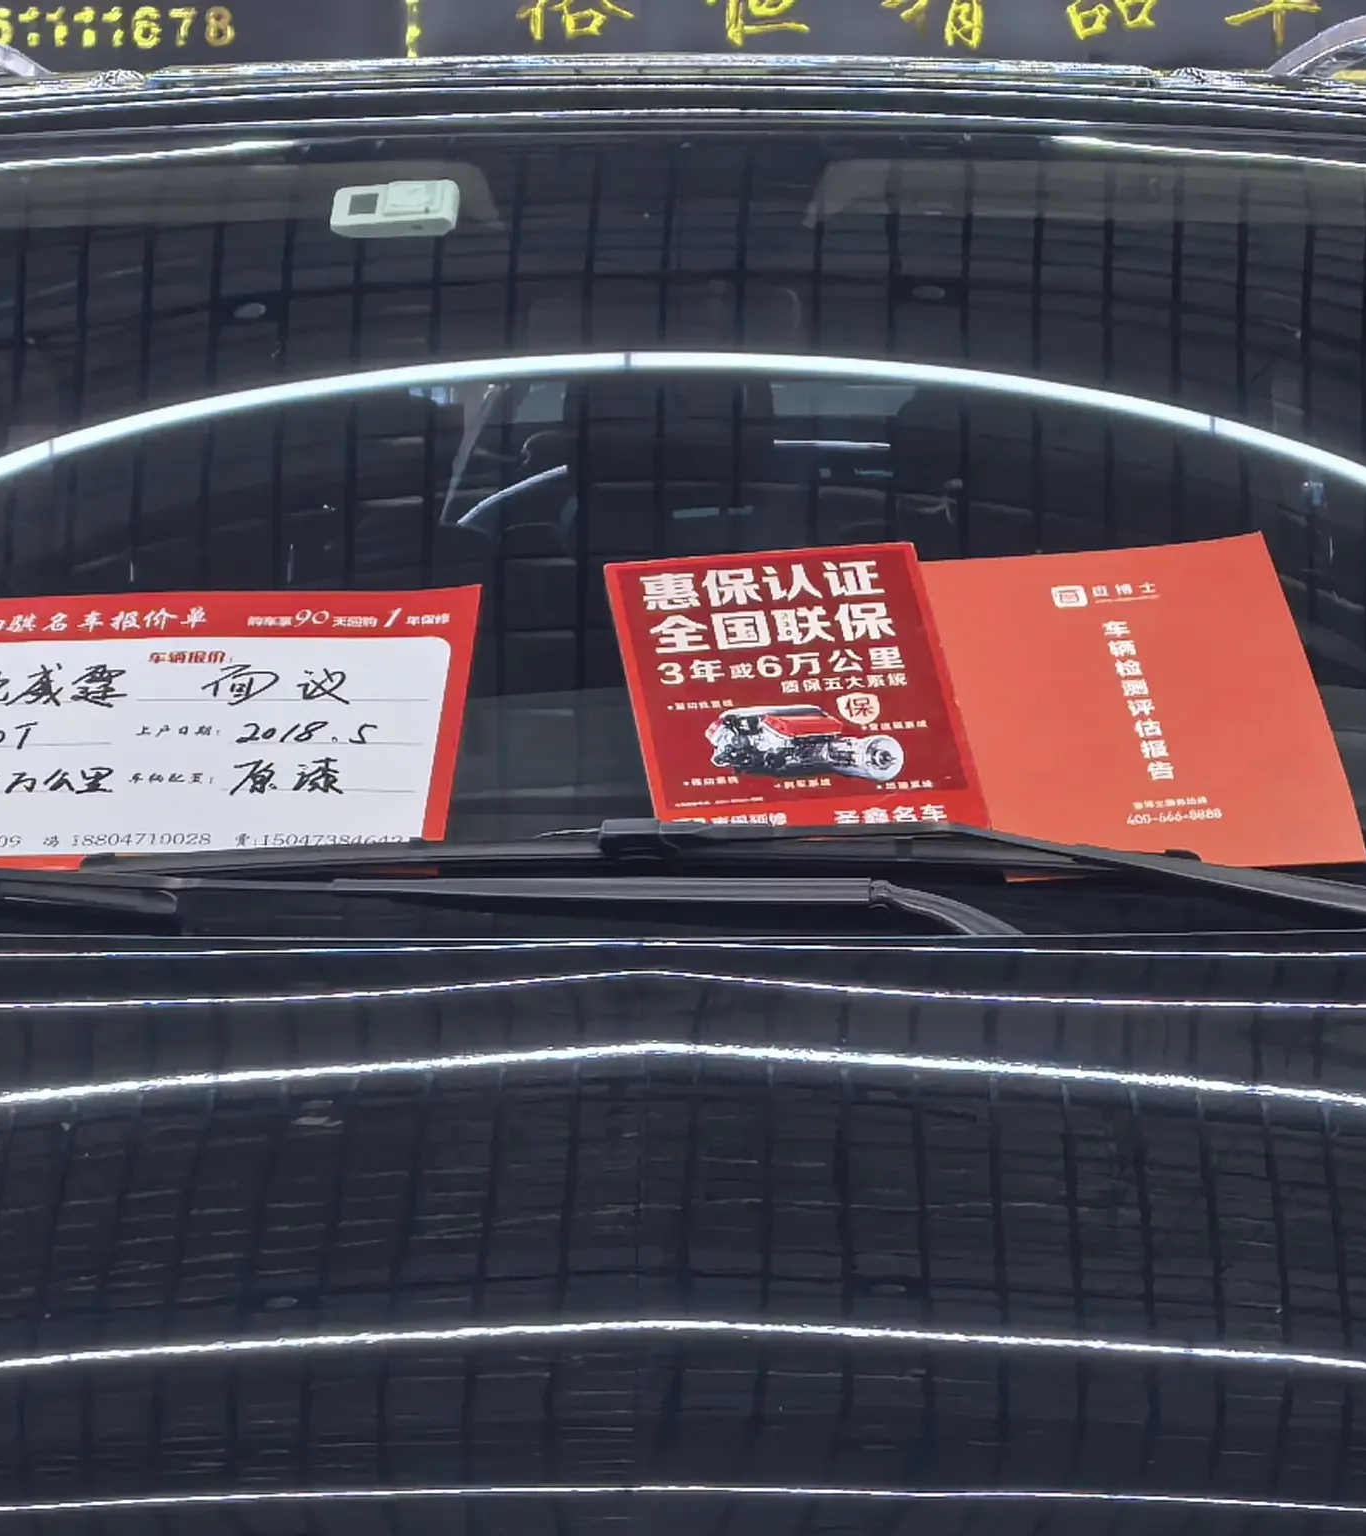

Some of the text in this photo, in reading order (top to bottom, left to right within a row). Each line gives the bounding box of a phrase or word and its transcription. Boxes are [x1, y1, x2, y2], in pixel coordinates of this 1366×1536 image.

[639, 560, 886, 611] 惠保认证
[649, 602, 897, 654] 全国联保
[201, 664, 350, 706] 面议
[656, 646, 906, 685] 3年或6万公里
[781, 672, 908, 694] 质保五大系统
[844, 696, 876, 717] 保
[1102, 620, 1175, 781] 车辆检测评估报告
